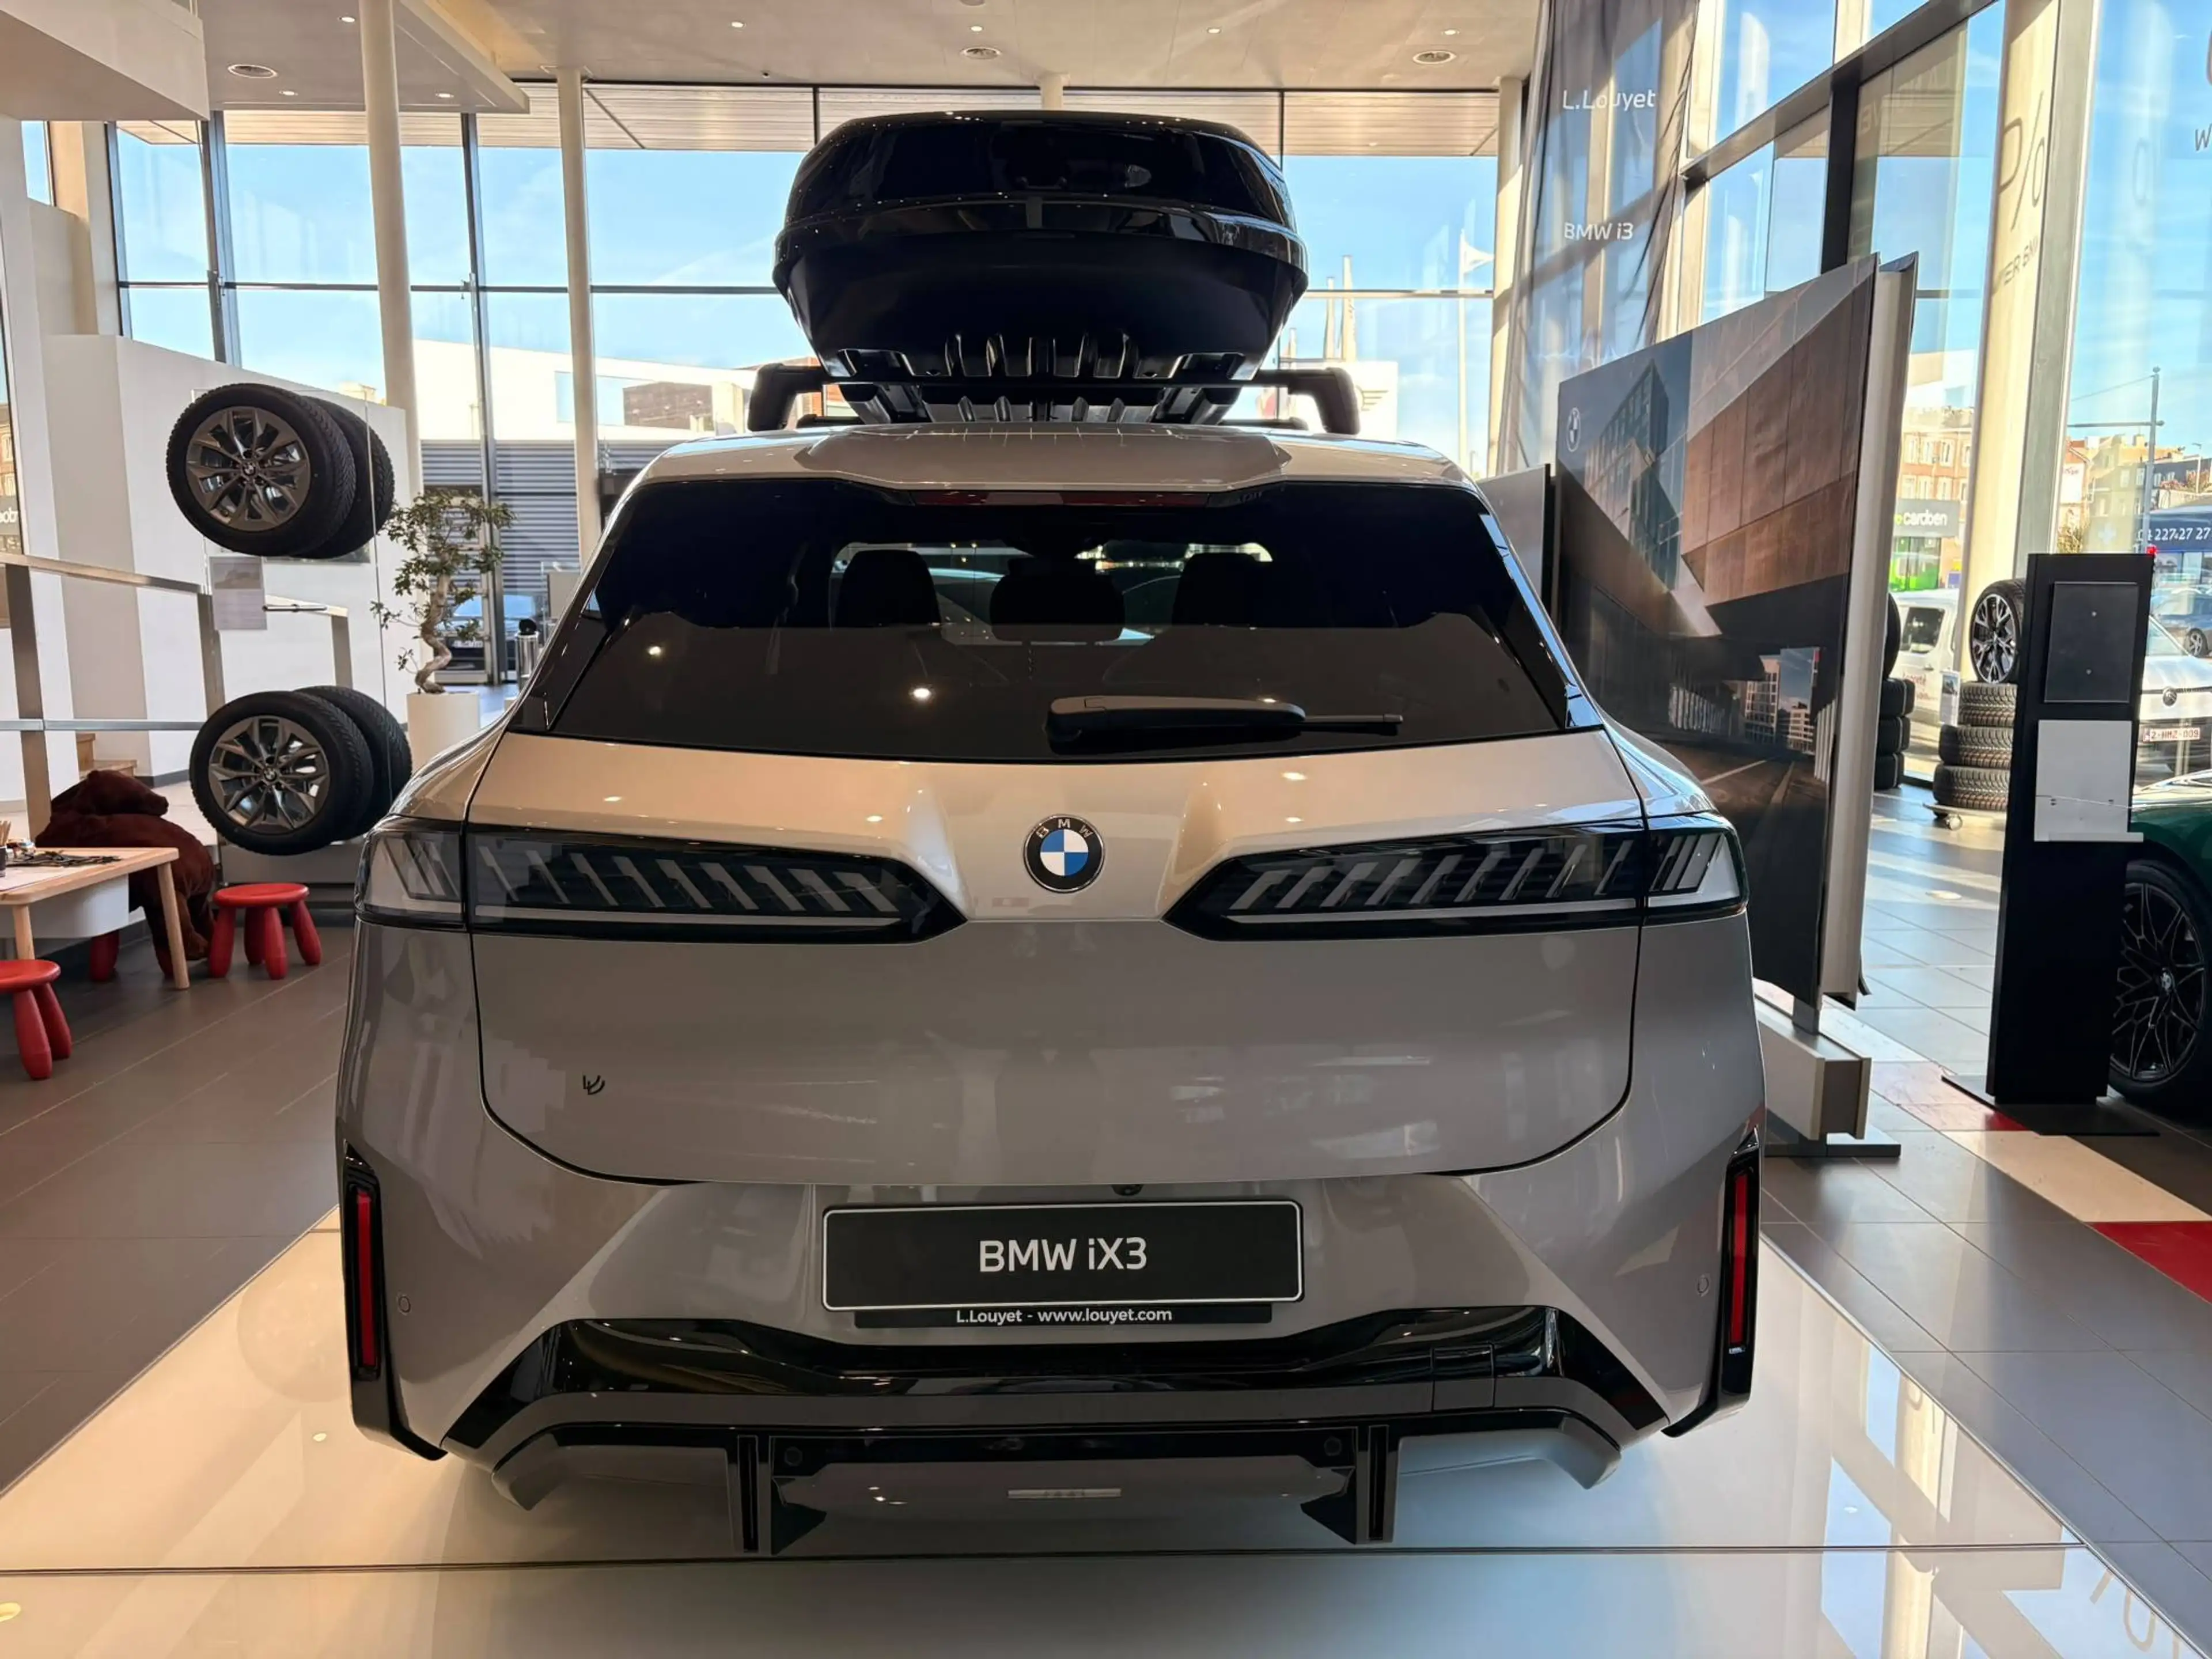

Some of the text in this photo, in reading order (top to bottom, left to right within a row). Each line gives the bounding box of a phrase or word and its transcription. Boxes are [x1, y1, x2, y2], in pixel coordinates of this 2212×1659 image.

[1563, 221, 1634, 240] BMW i3
[2195, 527, 2211, 540] 27
[1035, 819, 1094, 838] BMW
[979, 1237, 1147, 1272] BMW iX3
[956, 1309, 1023, 1326] L.Louyet
[1037, 1308, 1173, 1325] www.louyet.com
